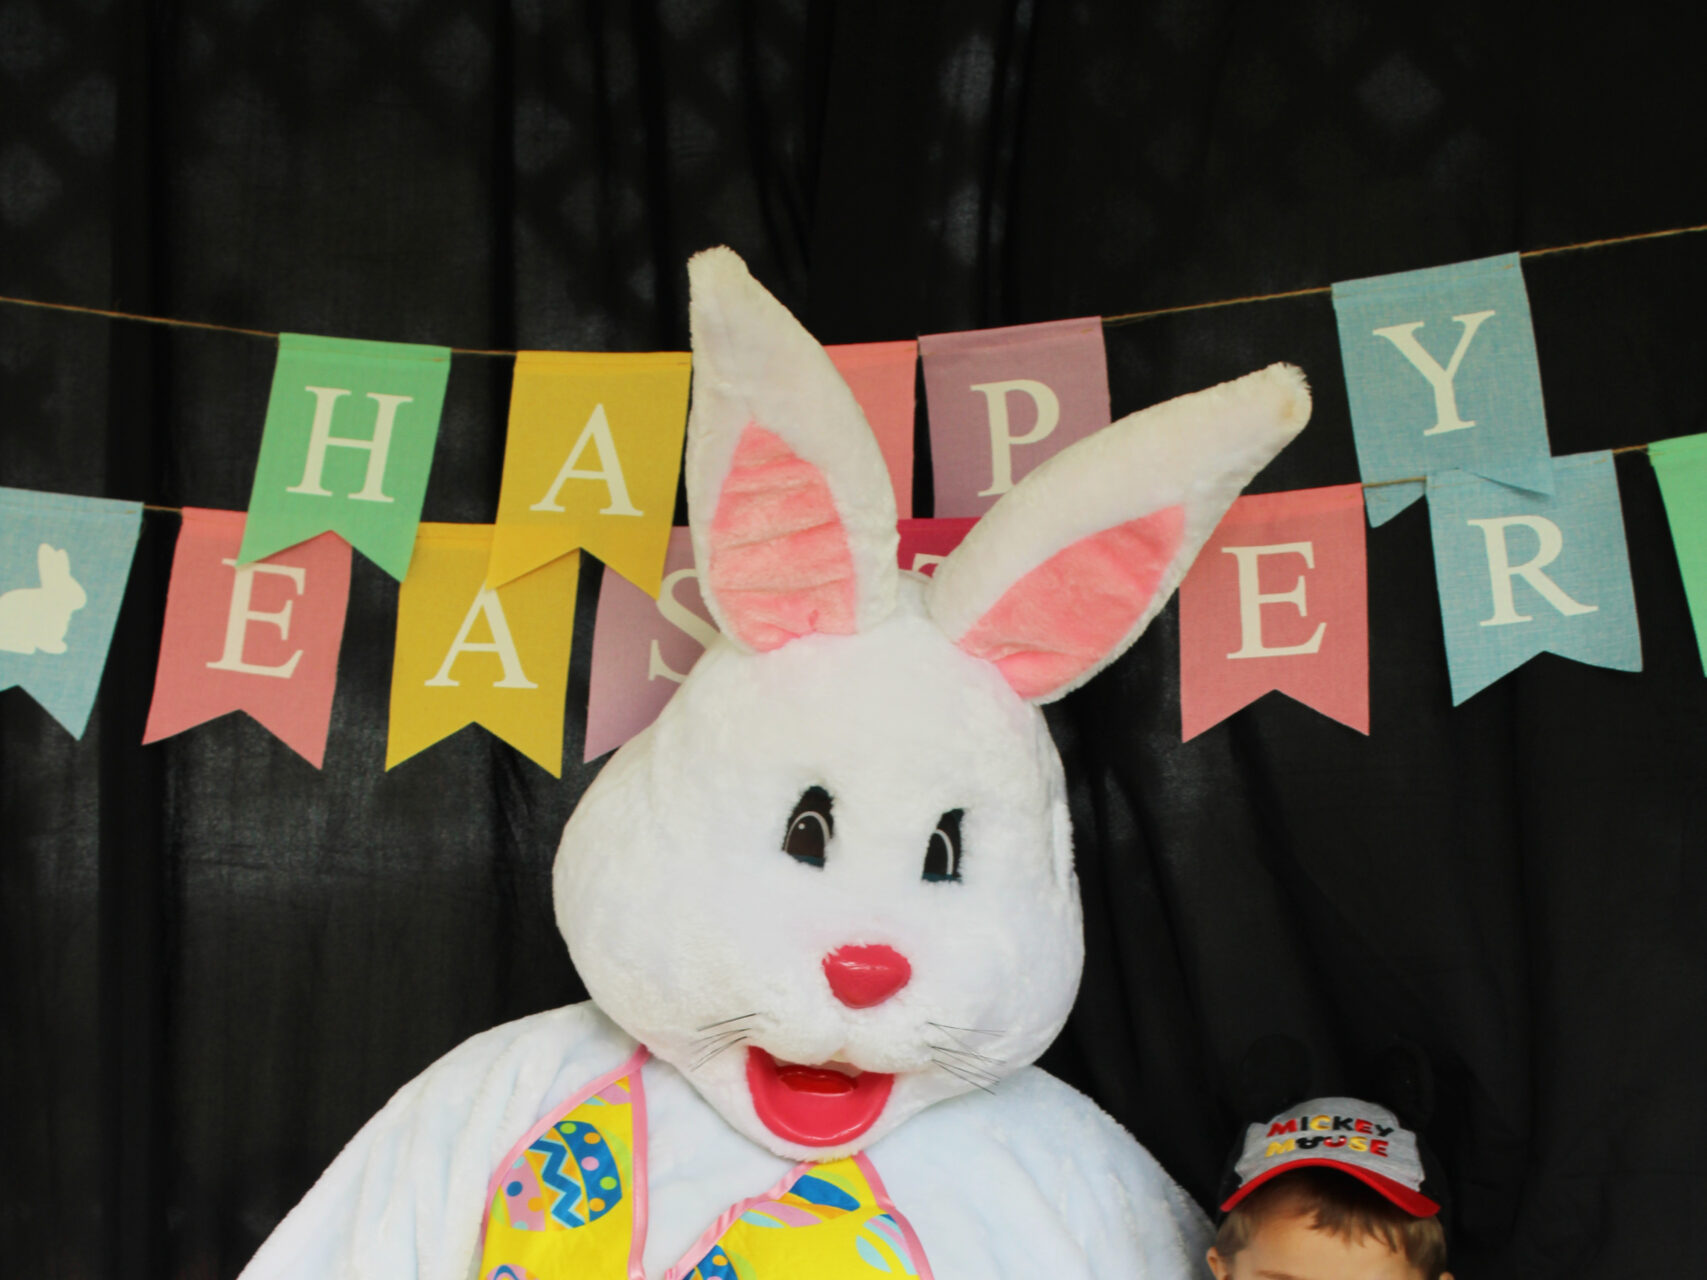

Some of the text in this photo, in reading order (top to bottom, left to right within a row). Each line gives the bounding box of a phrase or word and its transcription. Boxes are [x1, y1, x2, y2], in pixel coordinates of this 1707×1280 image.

[285, 310, 1496, 517] HAPY
[205, 514, 1599, 689] EASER
[1264, 1135, 1389, 1158] MOUSE
[1266, 1114, 1394, 1138] MICKEY
